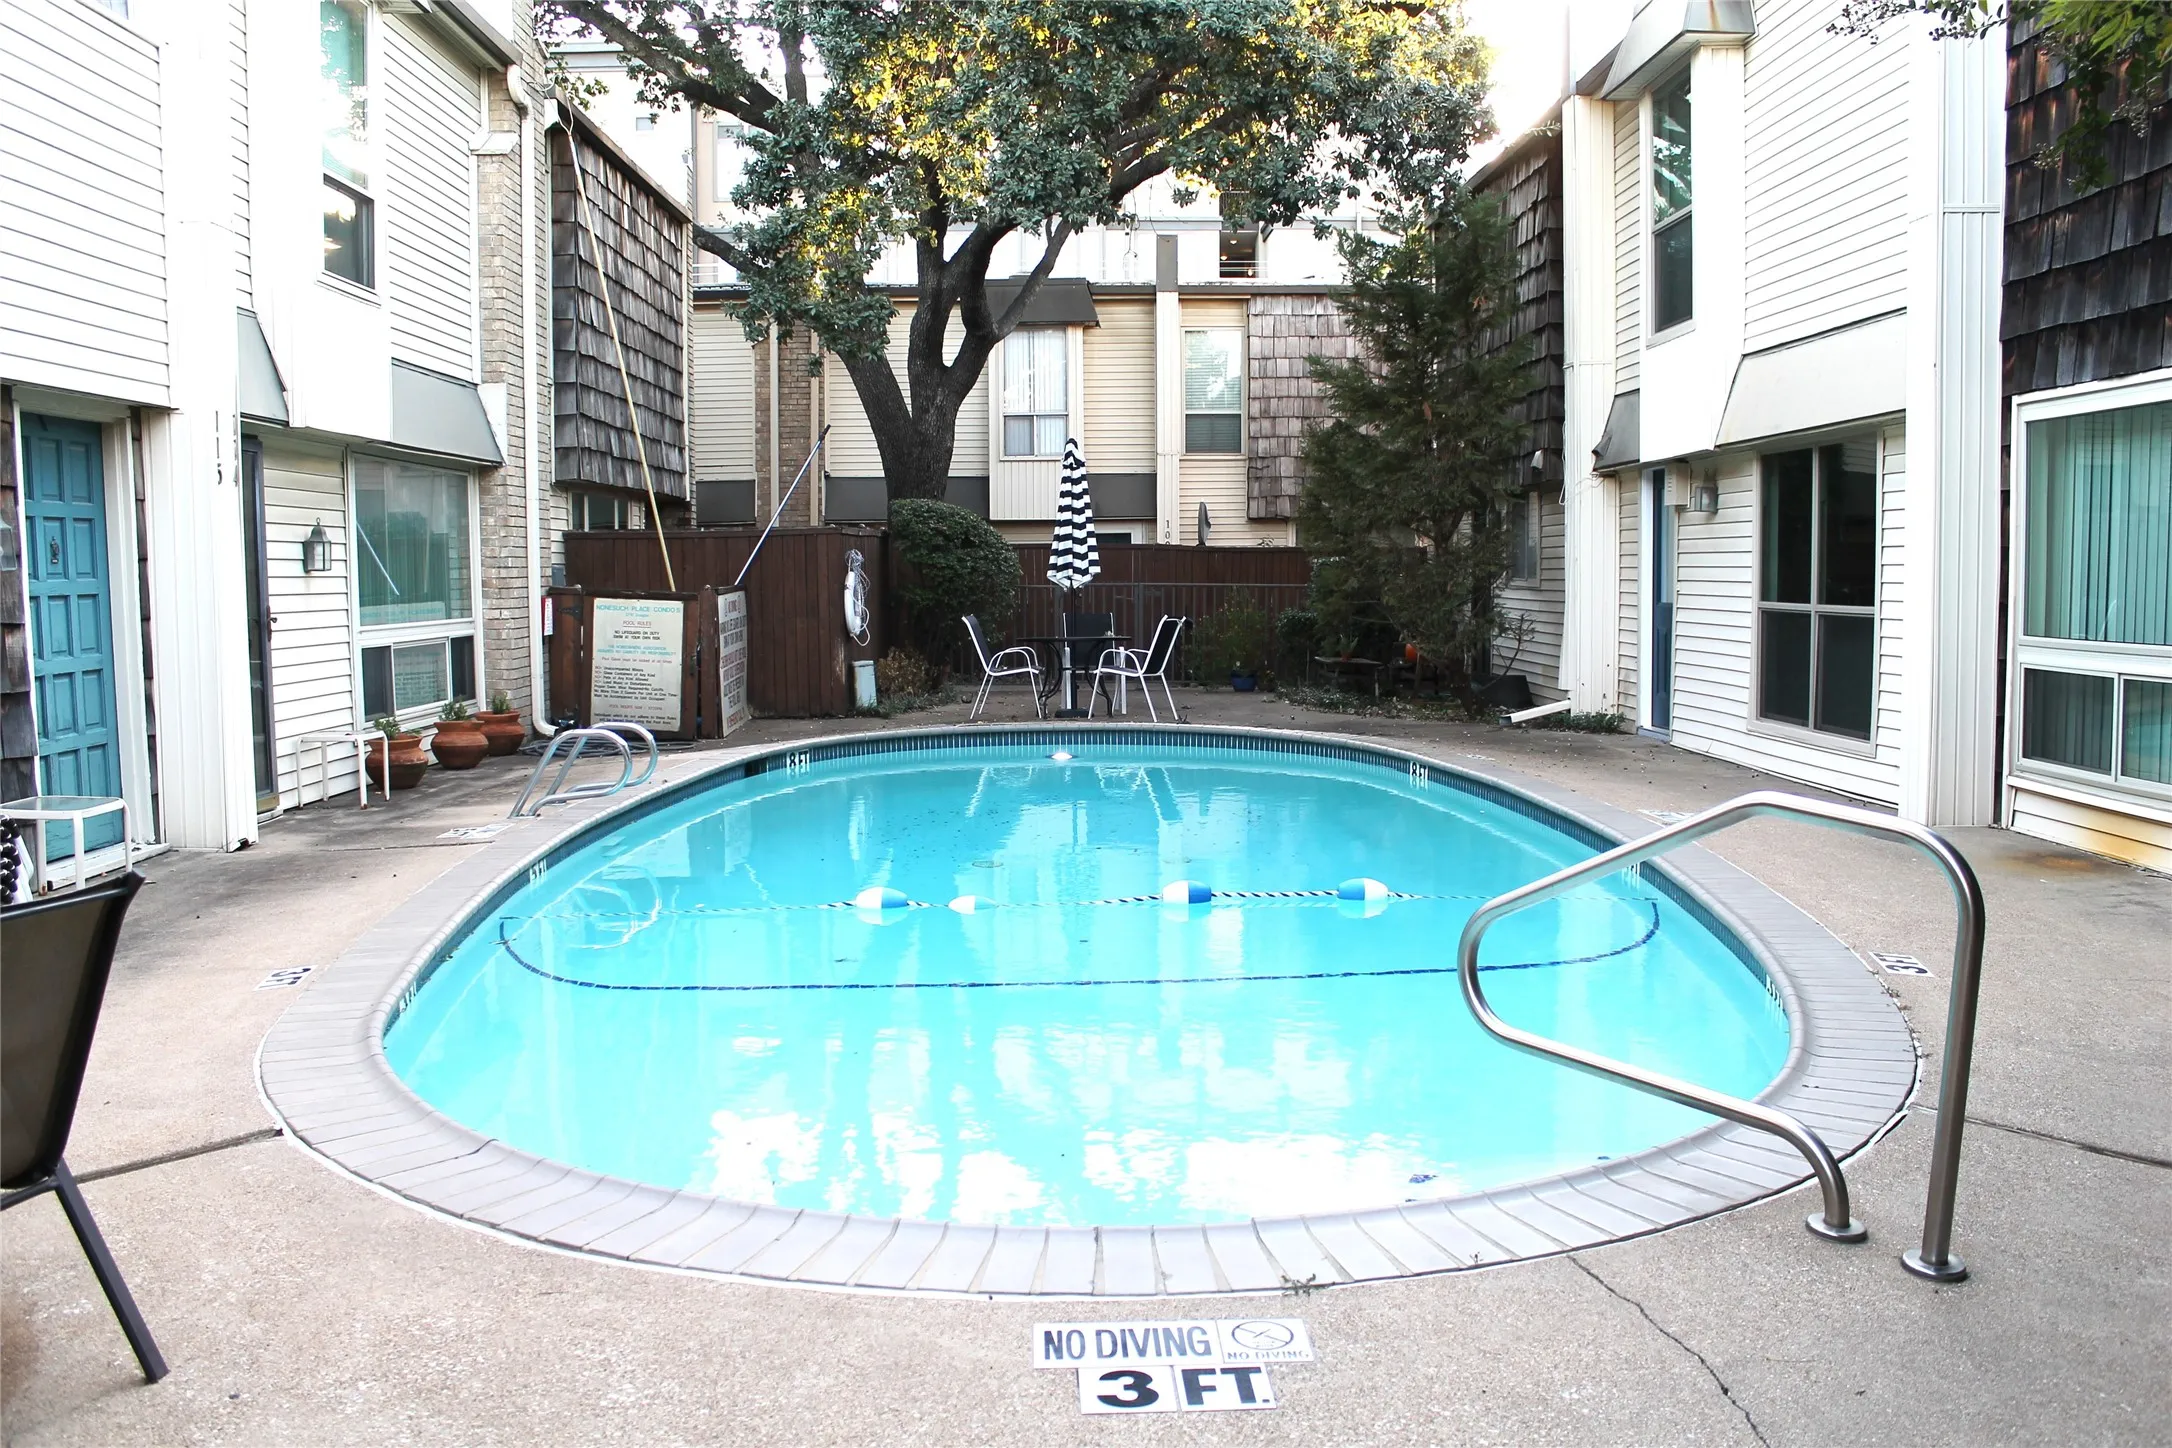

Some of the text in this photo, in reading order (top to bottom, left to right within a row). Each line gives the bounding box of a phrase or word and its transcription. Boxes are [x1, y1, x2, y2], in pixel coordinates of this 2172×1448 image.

[789, 750, 809, 768] 8 FT
[1411, 761, 1418, 777] 8
[1872, 952, 1928, 974] 3 FT
[258, 967, 312, 989] 3 FT
[1043, 1326, 1213, 1360] NO DIVING
[1227, 1350, 1310, 1360] NO DIVING
[1097, 1370, 1160, 1408] 3
